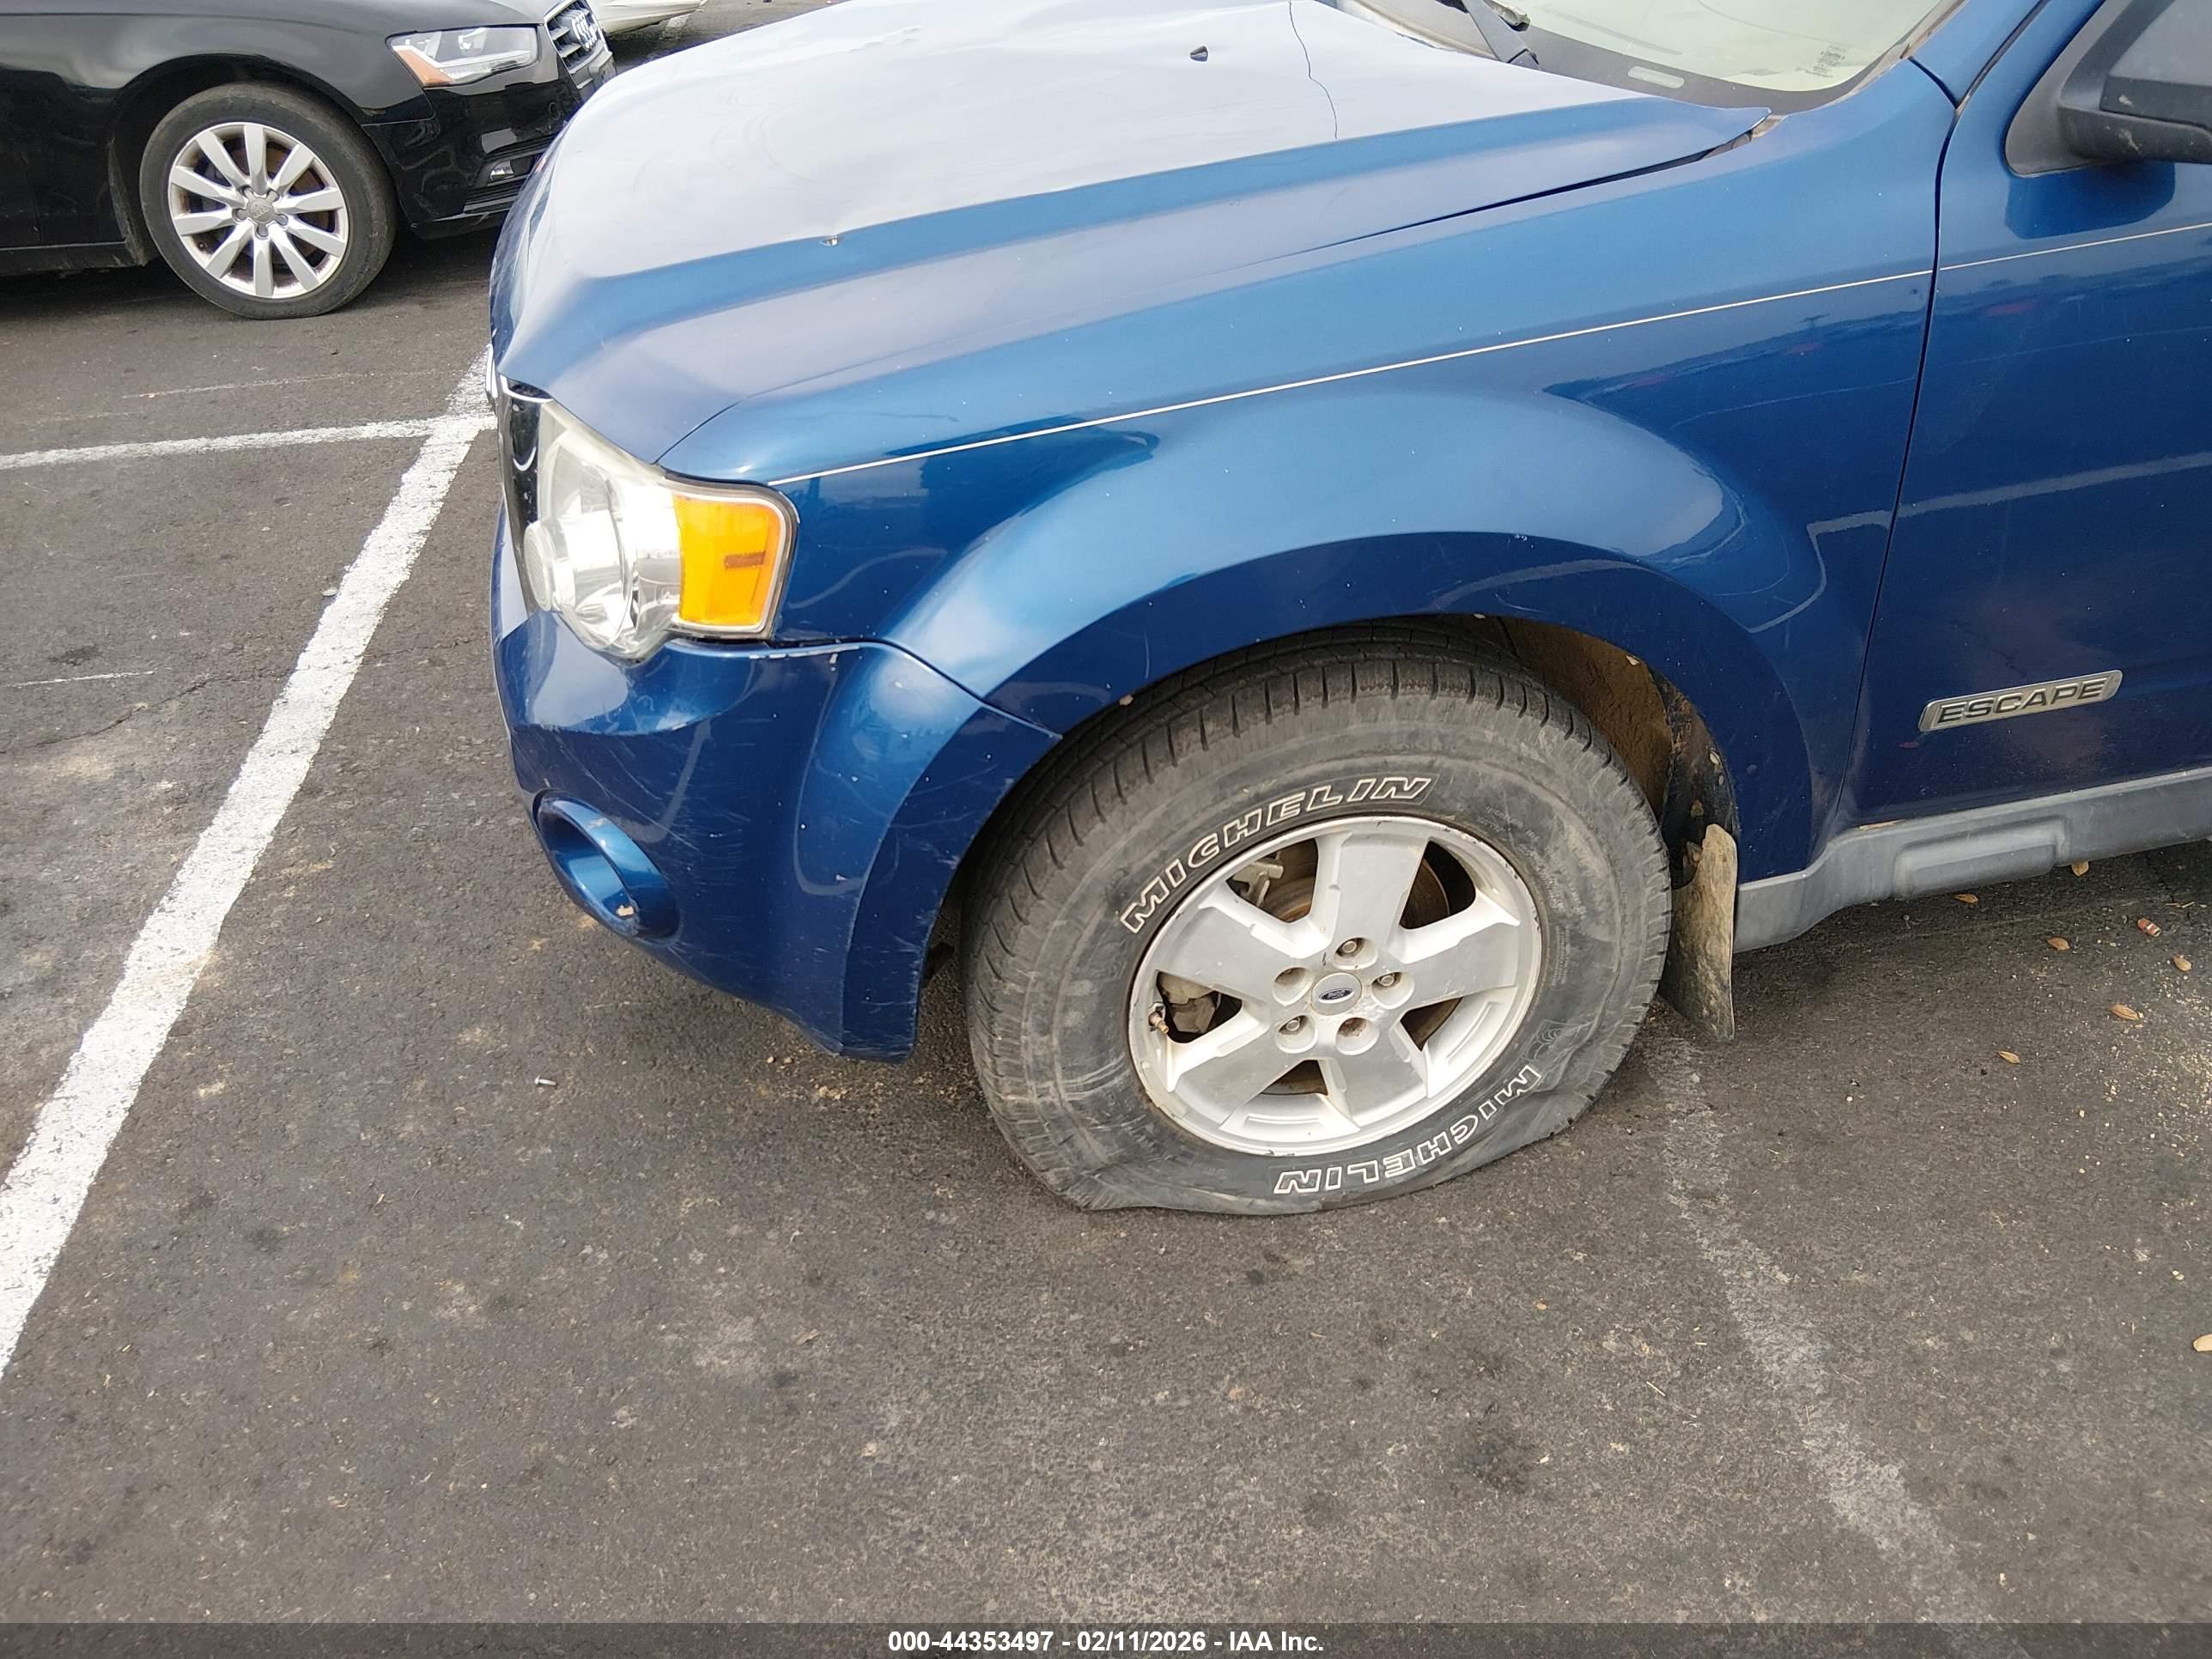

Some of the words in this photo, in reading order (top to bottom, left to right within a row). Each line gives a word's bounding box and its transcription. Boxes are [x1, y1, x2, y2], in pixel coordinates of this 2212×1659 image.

[1937, 677, 2109, 724] ESCAPE
[1120, 776, 1431, 934] MICHELIN
[1273, 1065, 1541, 1194] MICHELIN
